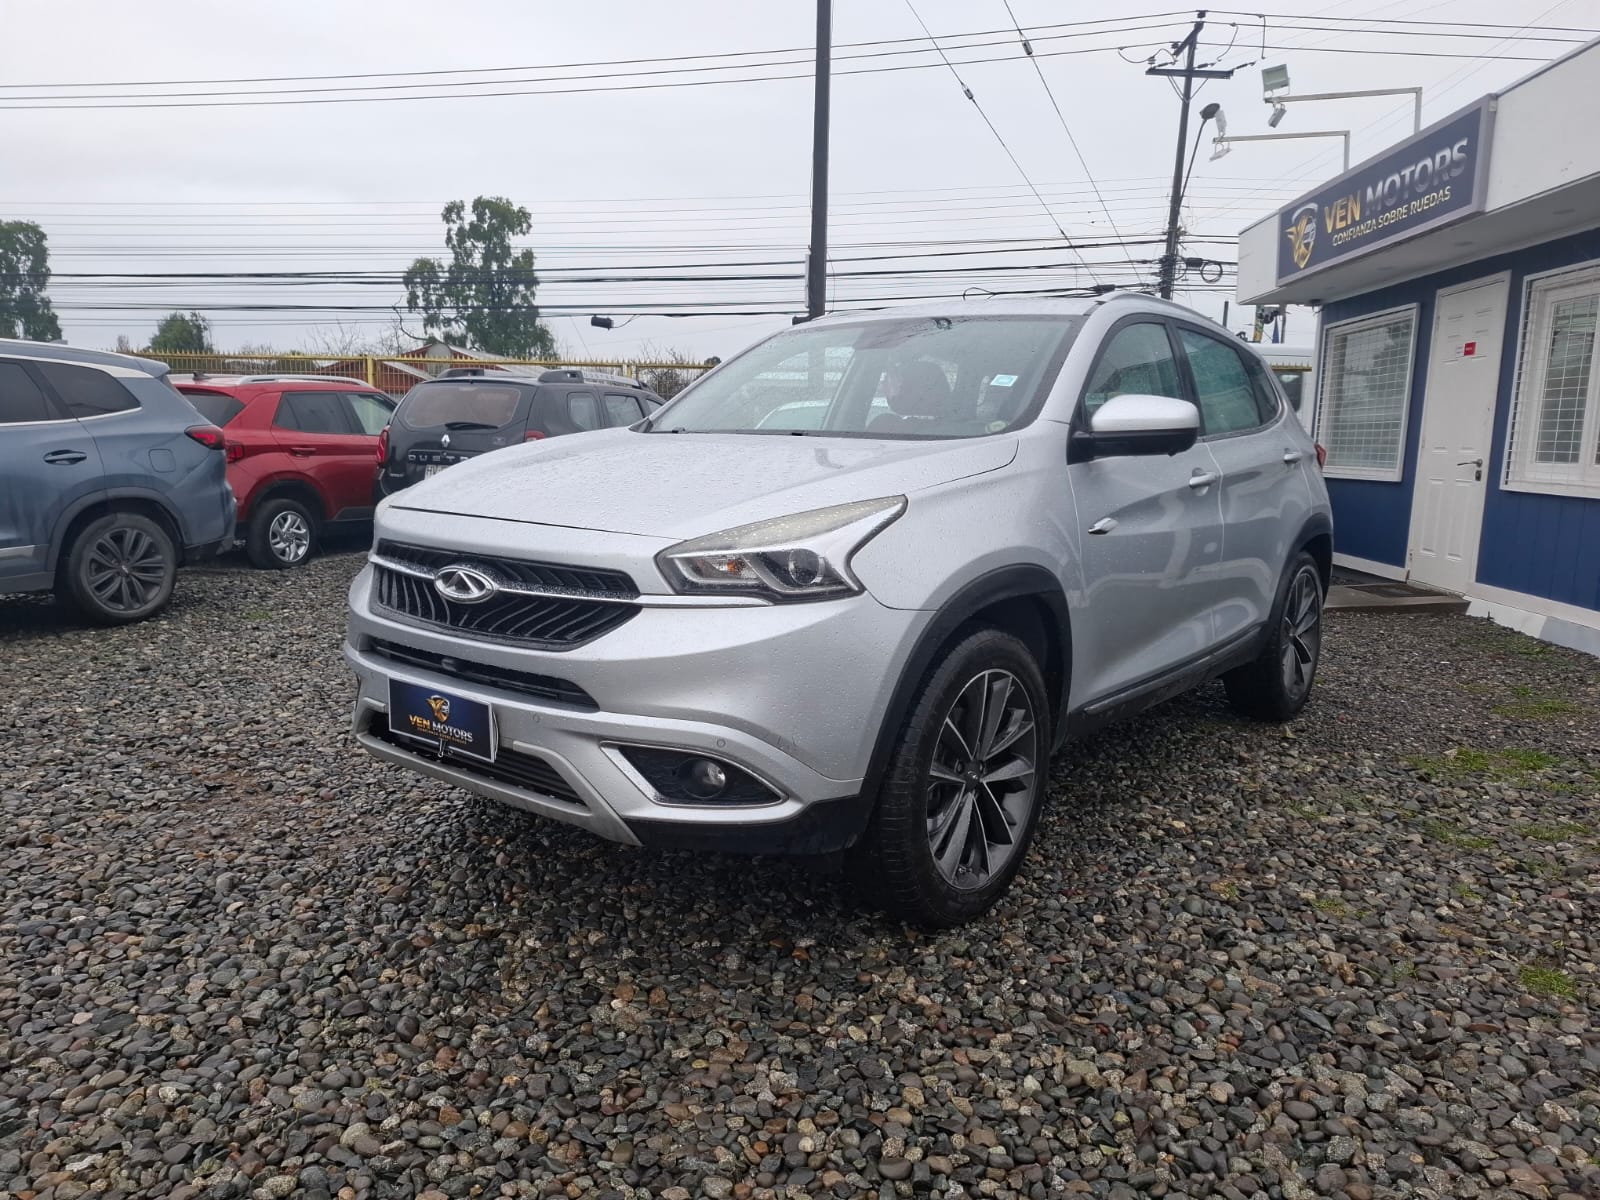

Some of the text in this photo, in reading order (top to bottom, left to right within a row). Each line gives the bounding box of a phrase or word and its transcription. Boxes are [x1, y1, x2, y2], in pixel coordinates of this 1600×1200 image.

[1324, 138, 1468, 233] VEN MOTORS
[1332, 186, 1451, 246] CONFIANZA SOBRE RUEDAS
[409, 714, 431, 730] VEN
[432, 722, 473, 742] MOTORS
